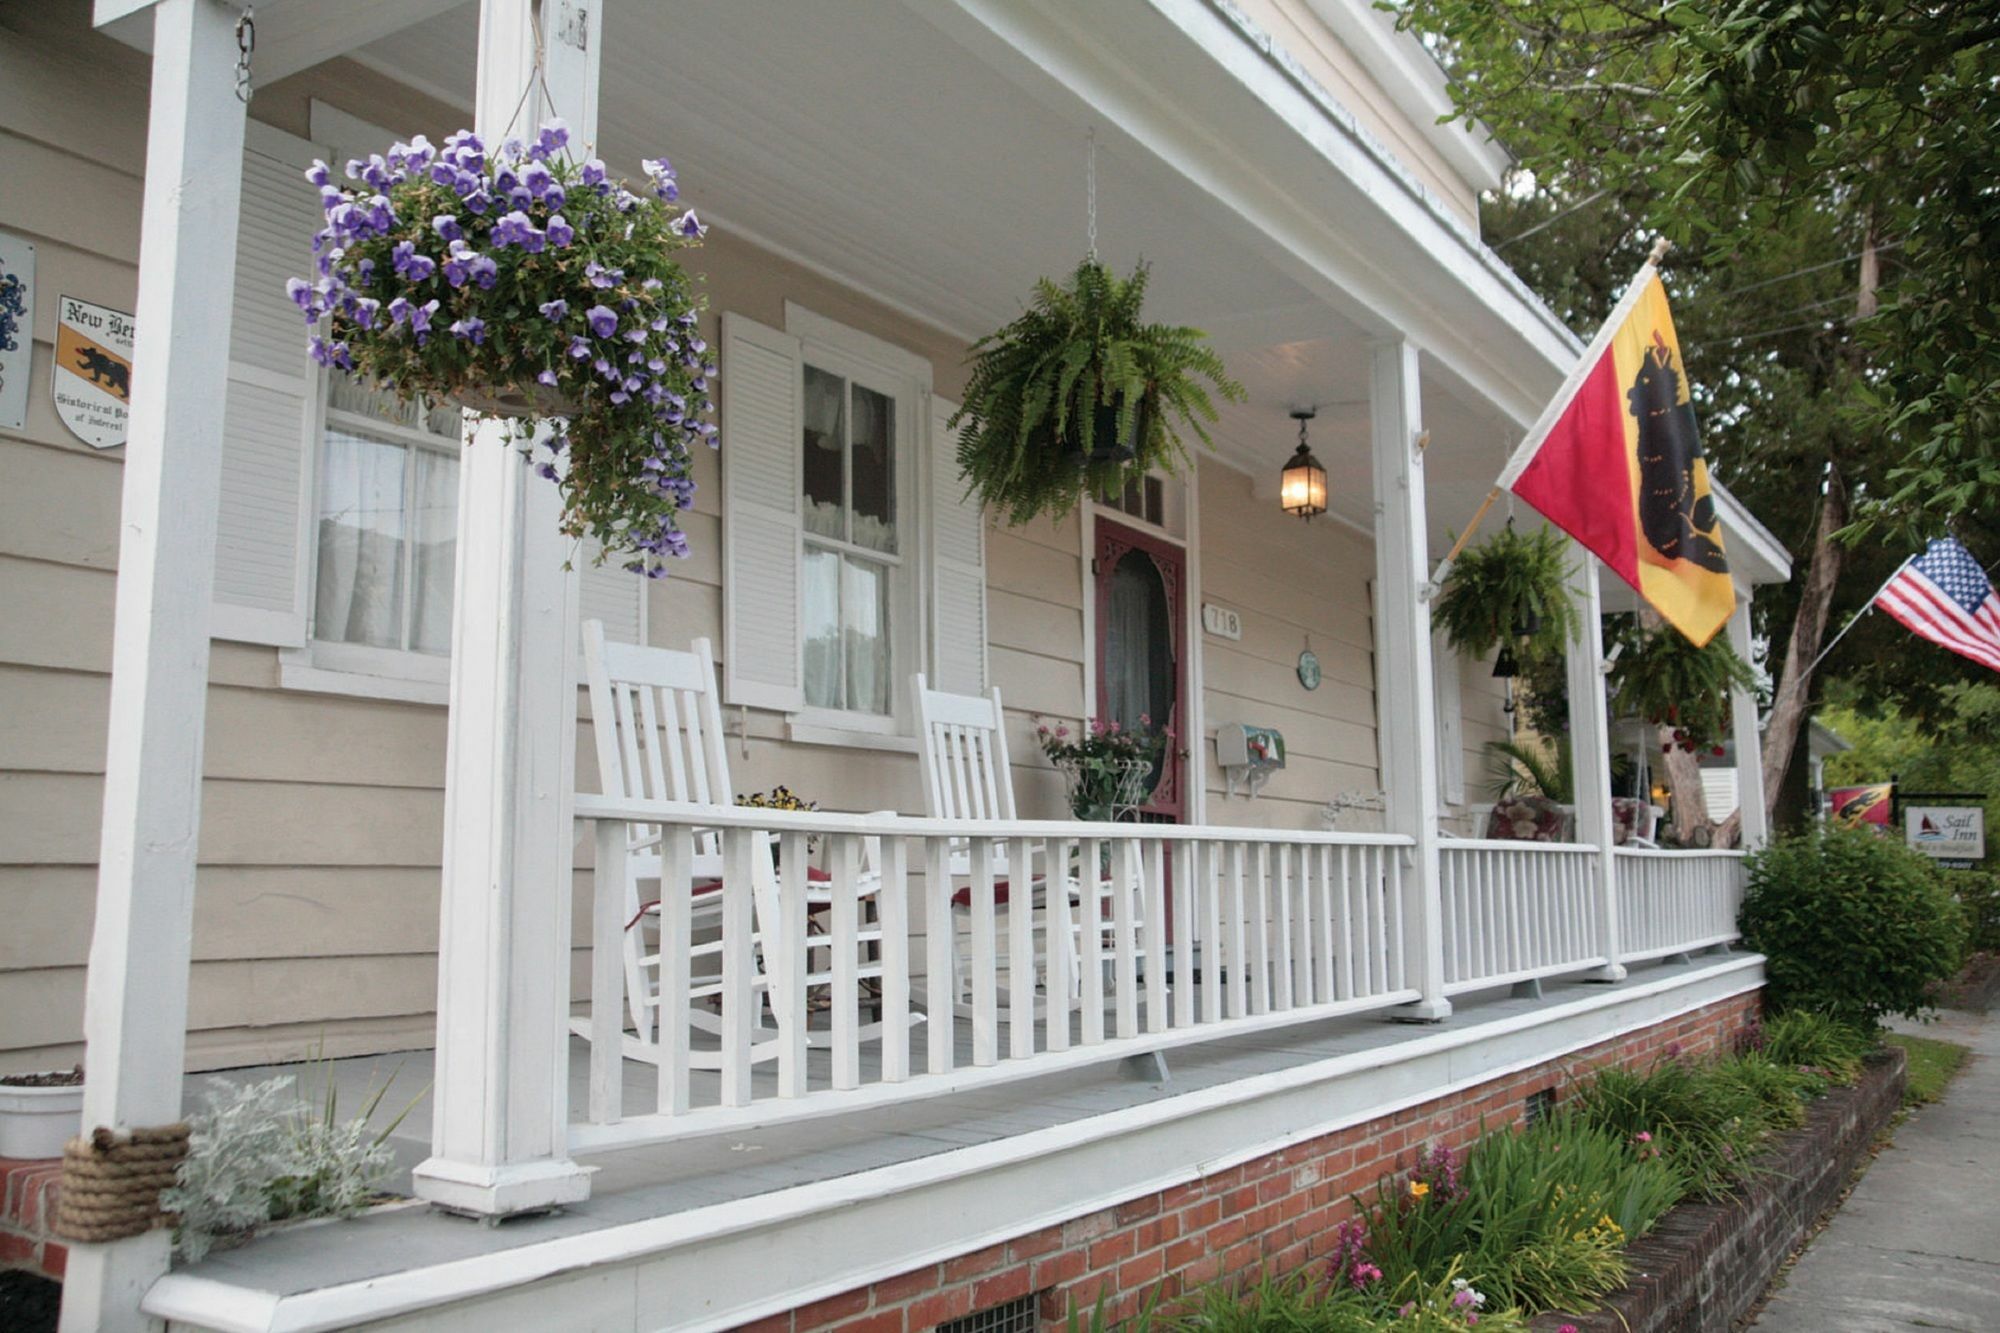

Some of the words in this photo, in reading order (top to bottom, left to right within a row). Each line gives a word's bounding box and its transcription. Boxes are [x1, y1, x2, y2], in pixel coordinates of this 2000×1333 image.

[67, 301, 102, 328] New
[57, 392, 112, 415] Historical
[1211, 608, 1237, 633] 718
[1942, 813, 1976, 829] Sail
[1952, 829, 1977, 841] Inn
